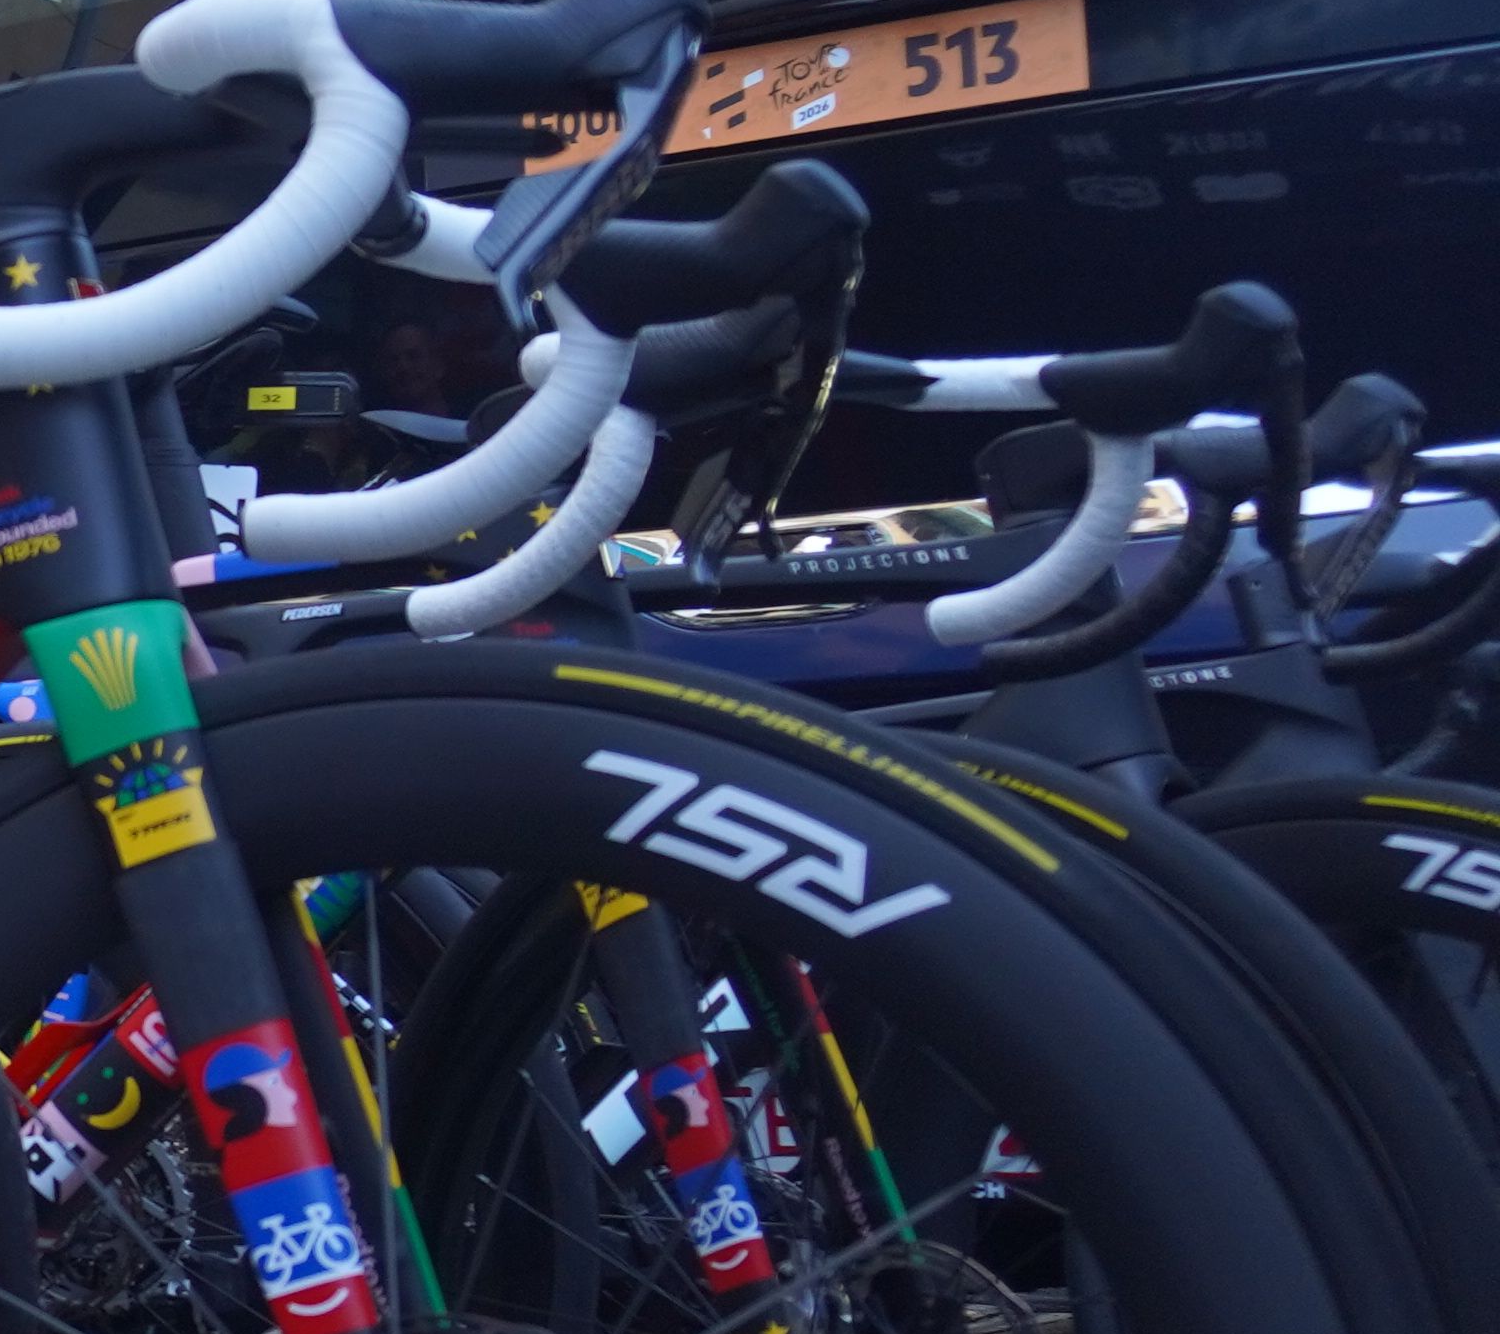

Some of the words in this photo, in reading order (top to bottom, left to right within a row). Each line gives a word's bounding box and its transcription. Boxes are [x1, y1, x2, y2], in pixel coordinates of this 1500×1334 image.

[904, 20, 1019, 99] 513
[798, 101, 830, 123] 2026
[260, 392, 282, 405] 32
[788, 550, 911, 575] PROJECT
[913, 545, 971, 565] ONE
[281, 602, 343, 622] PEDERSEN
[582, 748, 952, 938] RSL
[1381, 834, 1500, 912] SL
